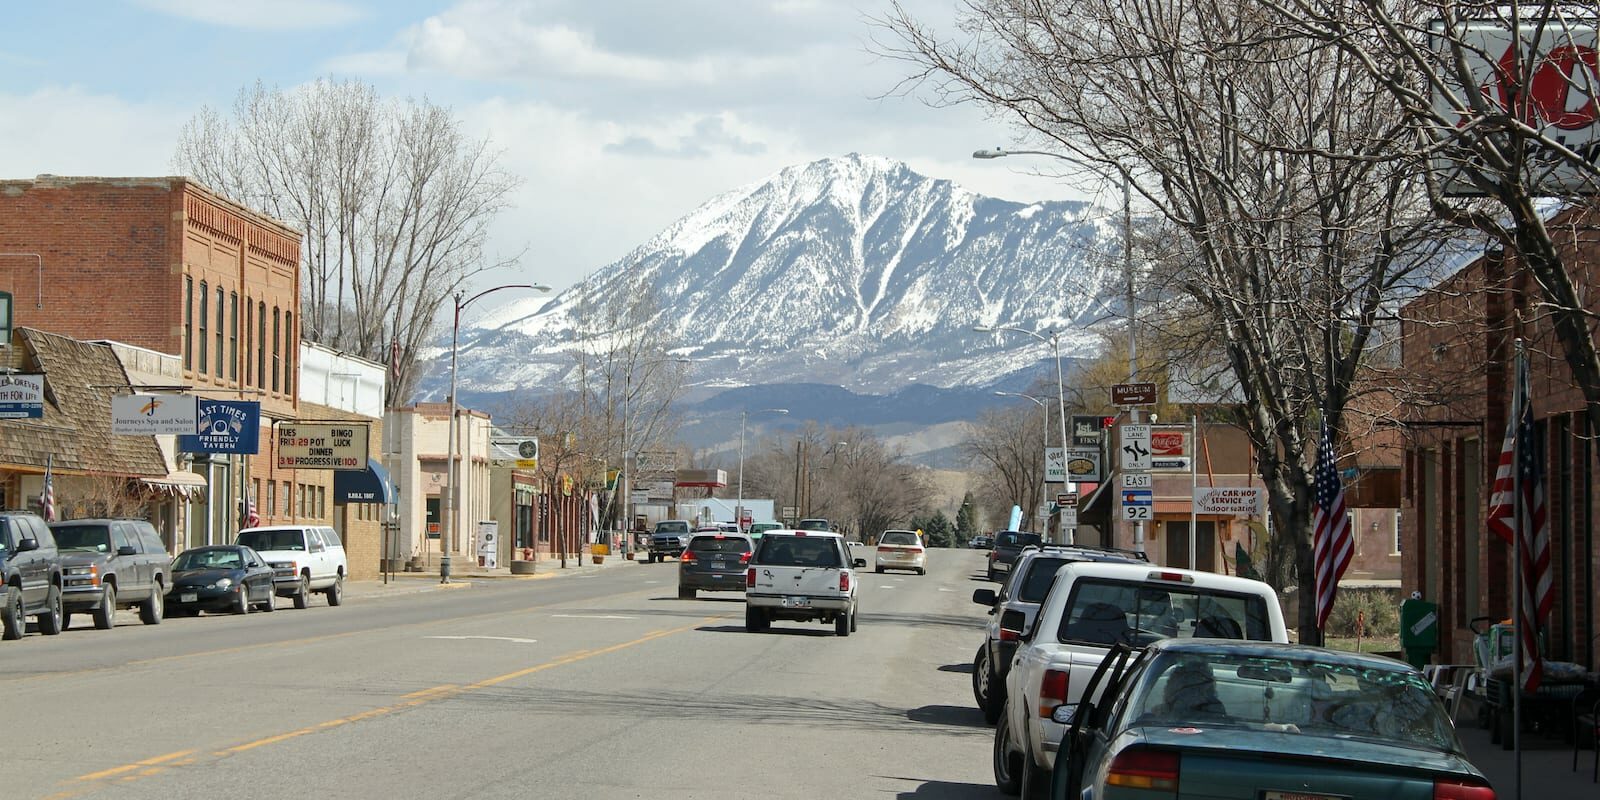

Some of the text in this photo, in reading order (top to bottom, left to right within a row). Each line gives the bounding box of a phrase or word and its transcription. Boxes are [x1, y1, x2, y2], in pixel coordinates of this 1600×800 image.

[12, 378, 40, 391] OREVER
[1117, 385, 1151, 395] MUSEUM
[10, 390, 24, 401] FOR
[25, 392, 37, 401] LIFE
[200, 405, 247, 421] AST TIMES
[114, 418, 145, 426] Journeys
[146, 418, 159, 426] Spa
[280, 428, 353, 438] TUES BINGO
[199, 435, 240, 443] FRIENDLY
[310, 438, 325, 446] POT
[333, 439, 351, 447] LUCK
[308, 447, 333, 456] DINNER
[295, 457, 342, 466] PROGRESSIVE
[1126, 476, 1147, 486] EAST
[1128, 507, 1147, 518] 92
[1230, 505, 1257, 513] seating
